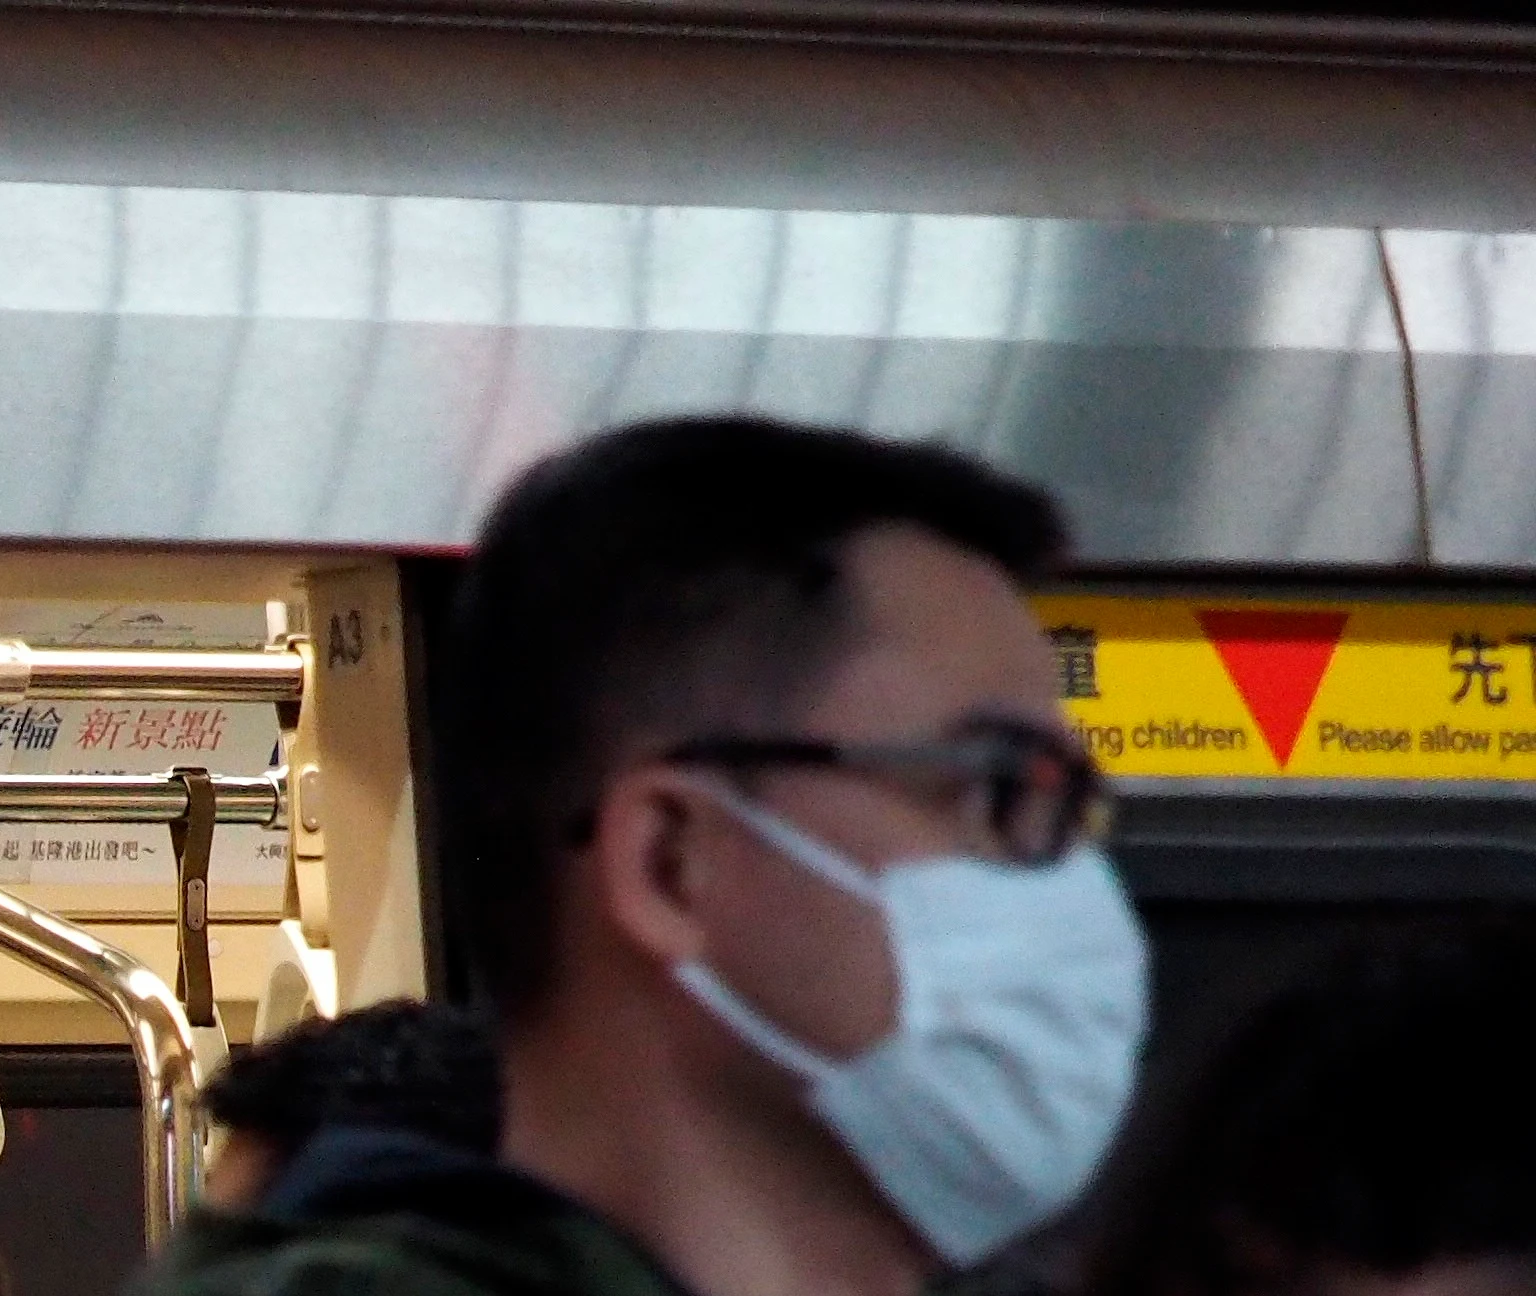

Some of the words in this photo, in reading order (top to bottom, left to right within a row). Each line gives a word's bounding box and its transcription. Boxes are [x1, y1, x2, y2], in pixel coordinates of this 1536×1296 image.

[328, 609, 364, 669] A3
[75, 706, 228, 752] 新景點
[1132, 718, 1248, 751] children
[1317, 720, 1413, 754] Please
[1419, 724, 1492, 753] allow
